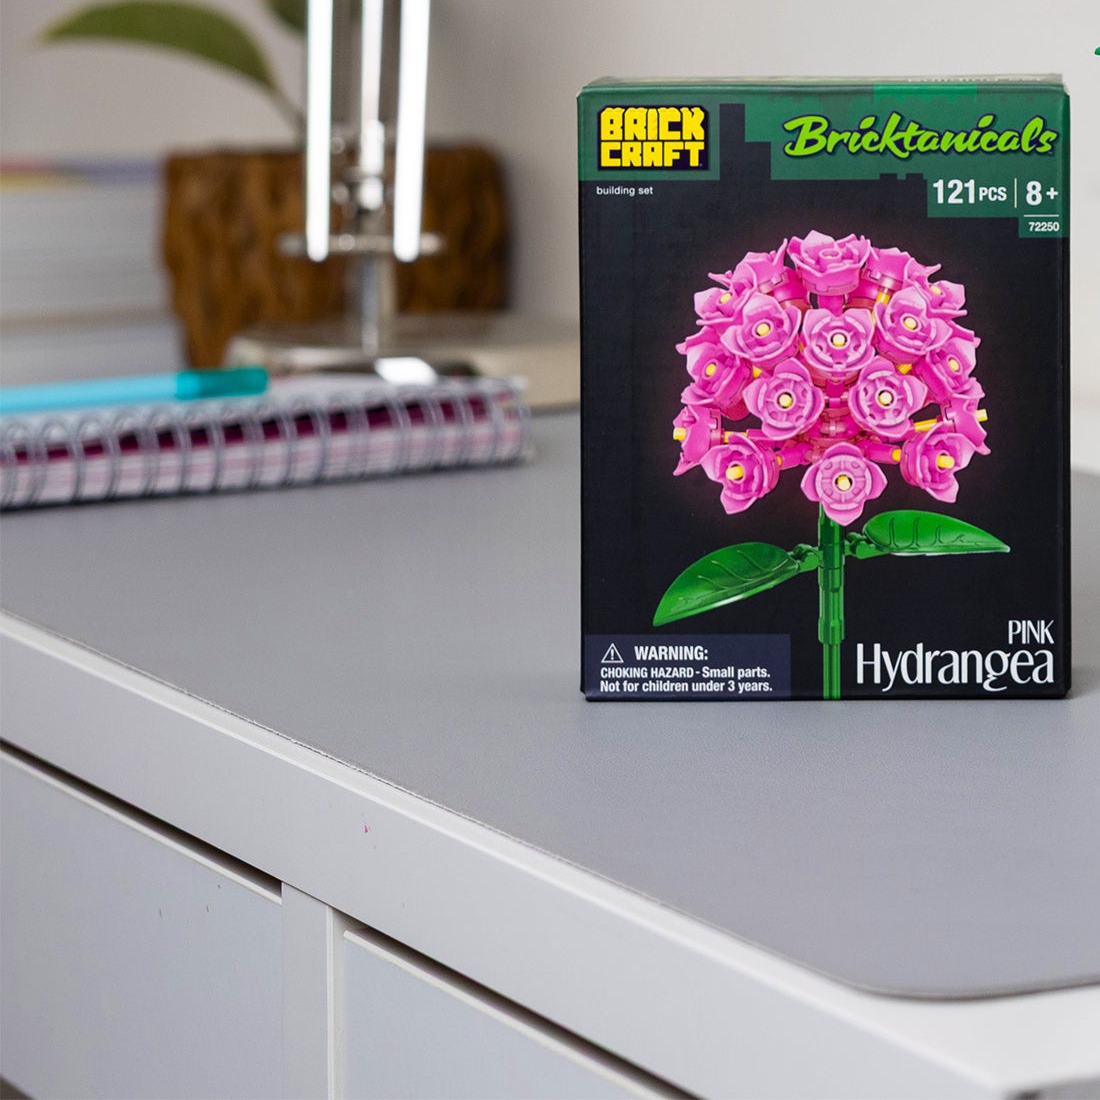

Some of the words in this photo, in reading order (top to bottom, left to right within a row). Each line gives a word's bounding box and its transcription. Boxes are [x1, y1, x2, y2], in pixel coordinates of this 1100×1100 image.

[600, 107, 705, 141] BRICK
[783, 112, 1057, 158] Bricktanicals
[600, 141, 705, 167] CRAFT
[596, 186, 636, 197] building
[638, 186, 654, 195] set
[1028, 221, 1060, 232] 72250
[1008, 620, 1055, 645] PINK
[634, 645, 709, 661] WARNING:
[600, 667, 648, 679] CHOKING
[650, 667, 694, 678] HAZARD
[702, 666, 735, 678] Small
[737, 666, 771, 680] parts.
[856, 642, 1055, 693] Hydrangea
[600, 680, 620, 692] Not
[623, 680, 640, 692] for
[642, 680, 689, 692] children
[692, 680, 725, 692] under
[727, 680, 736, 692] 3
[738, 681, 773, 694] years.
